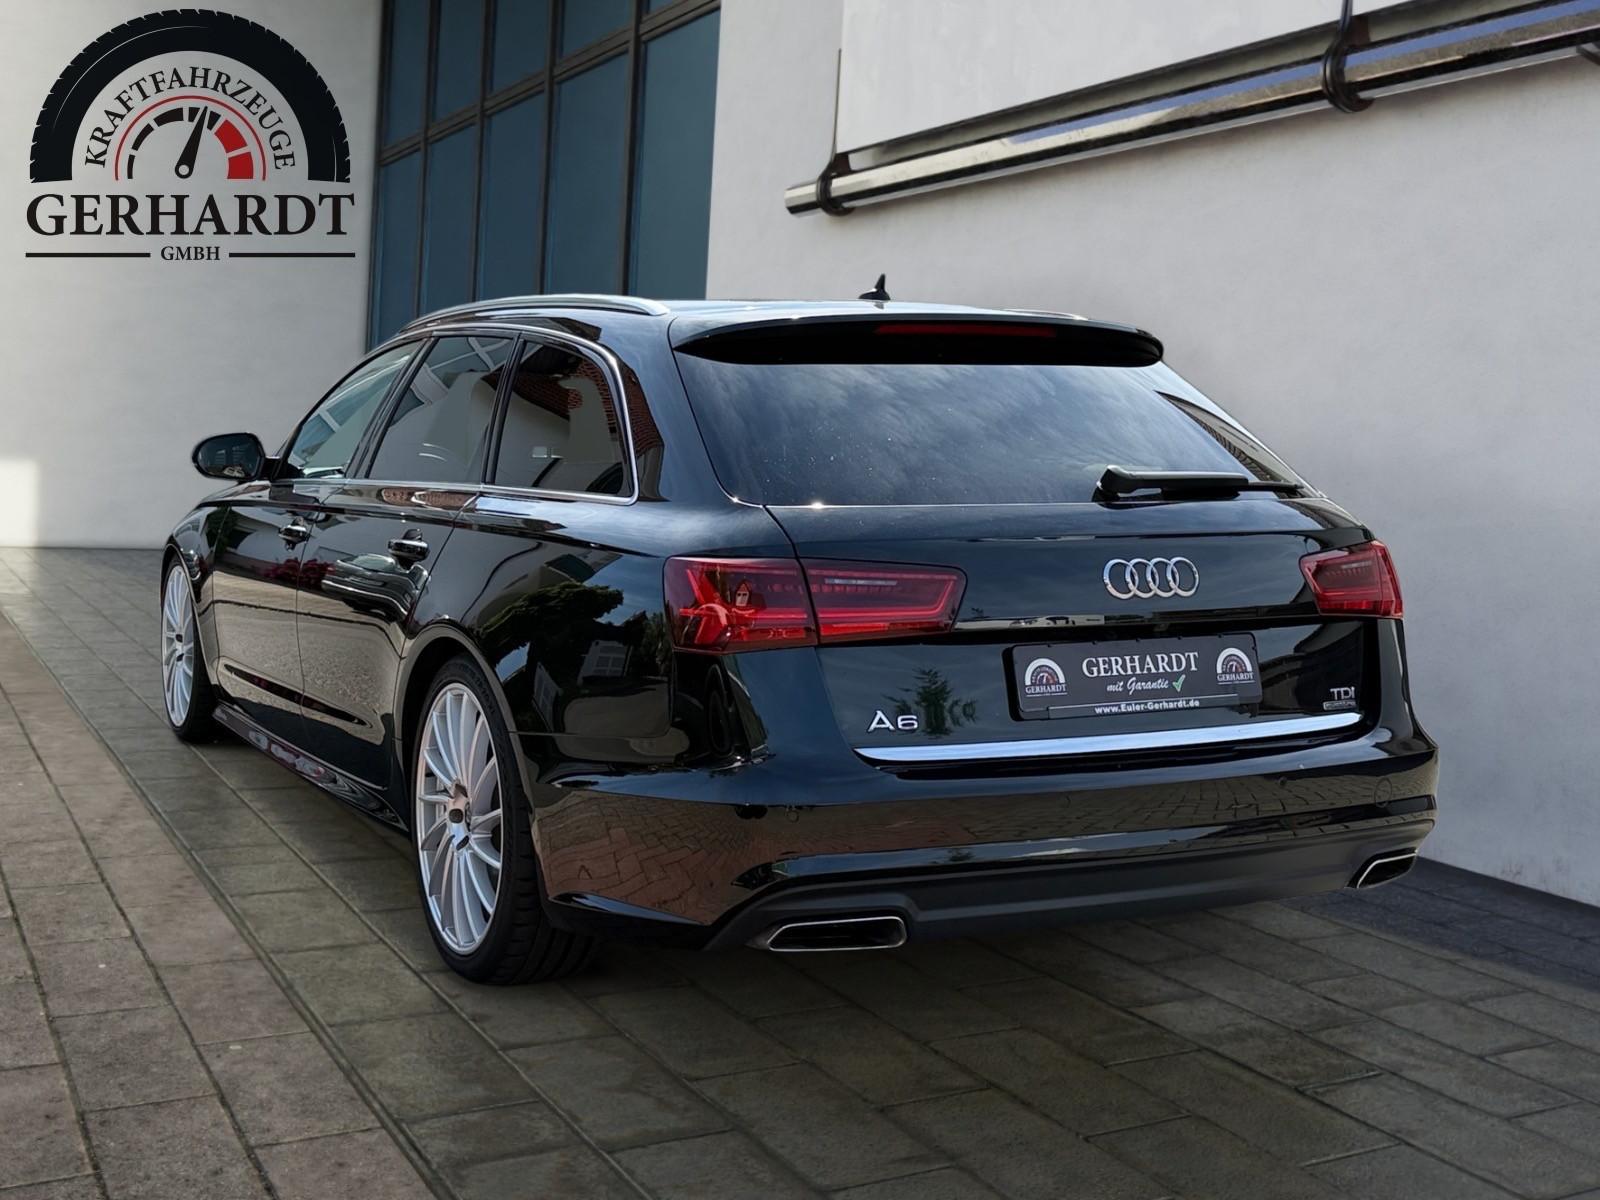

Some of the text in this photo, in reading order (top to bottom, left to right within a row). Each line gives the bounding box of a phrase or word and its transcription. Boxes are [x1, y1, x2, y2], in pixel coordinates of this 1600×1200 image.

[1081, 651, 1199, 678] GERHARDT
[1217, 672, 1255, 682] GERHARDT
[1025, 684, 1067, 694] GERHARDT
[1106, 676, 1169, 696] mit Garantie
[1329, 686, 1356, 700] TDI
[1094, 699, 1201, 715] www.Euler-Gerhardt.de
[866, 710, 919, 733] A6
